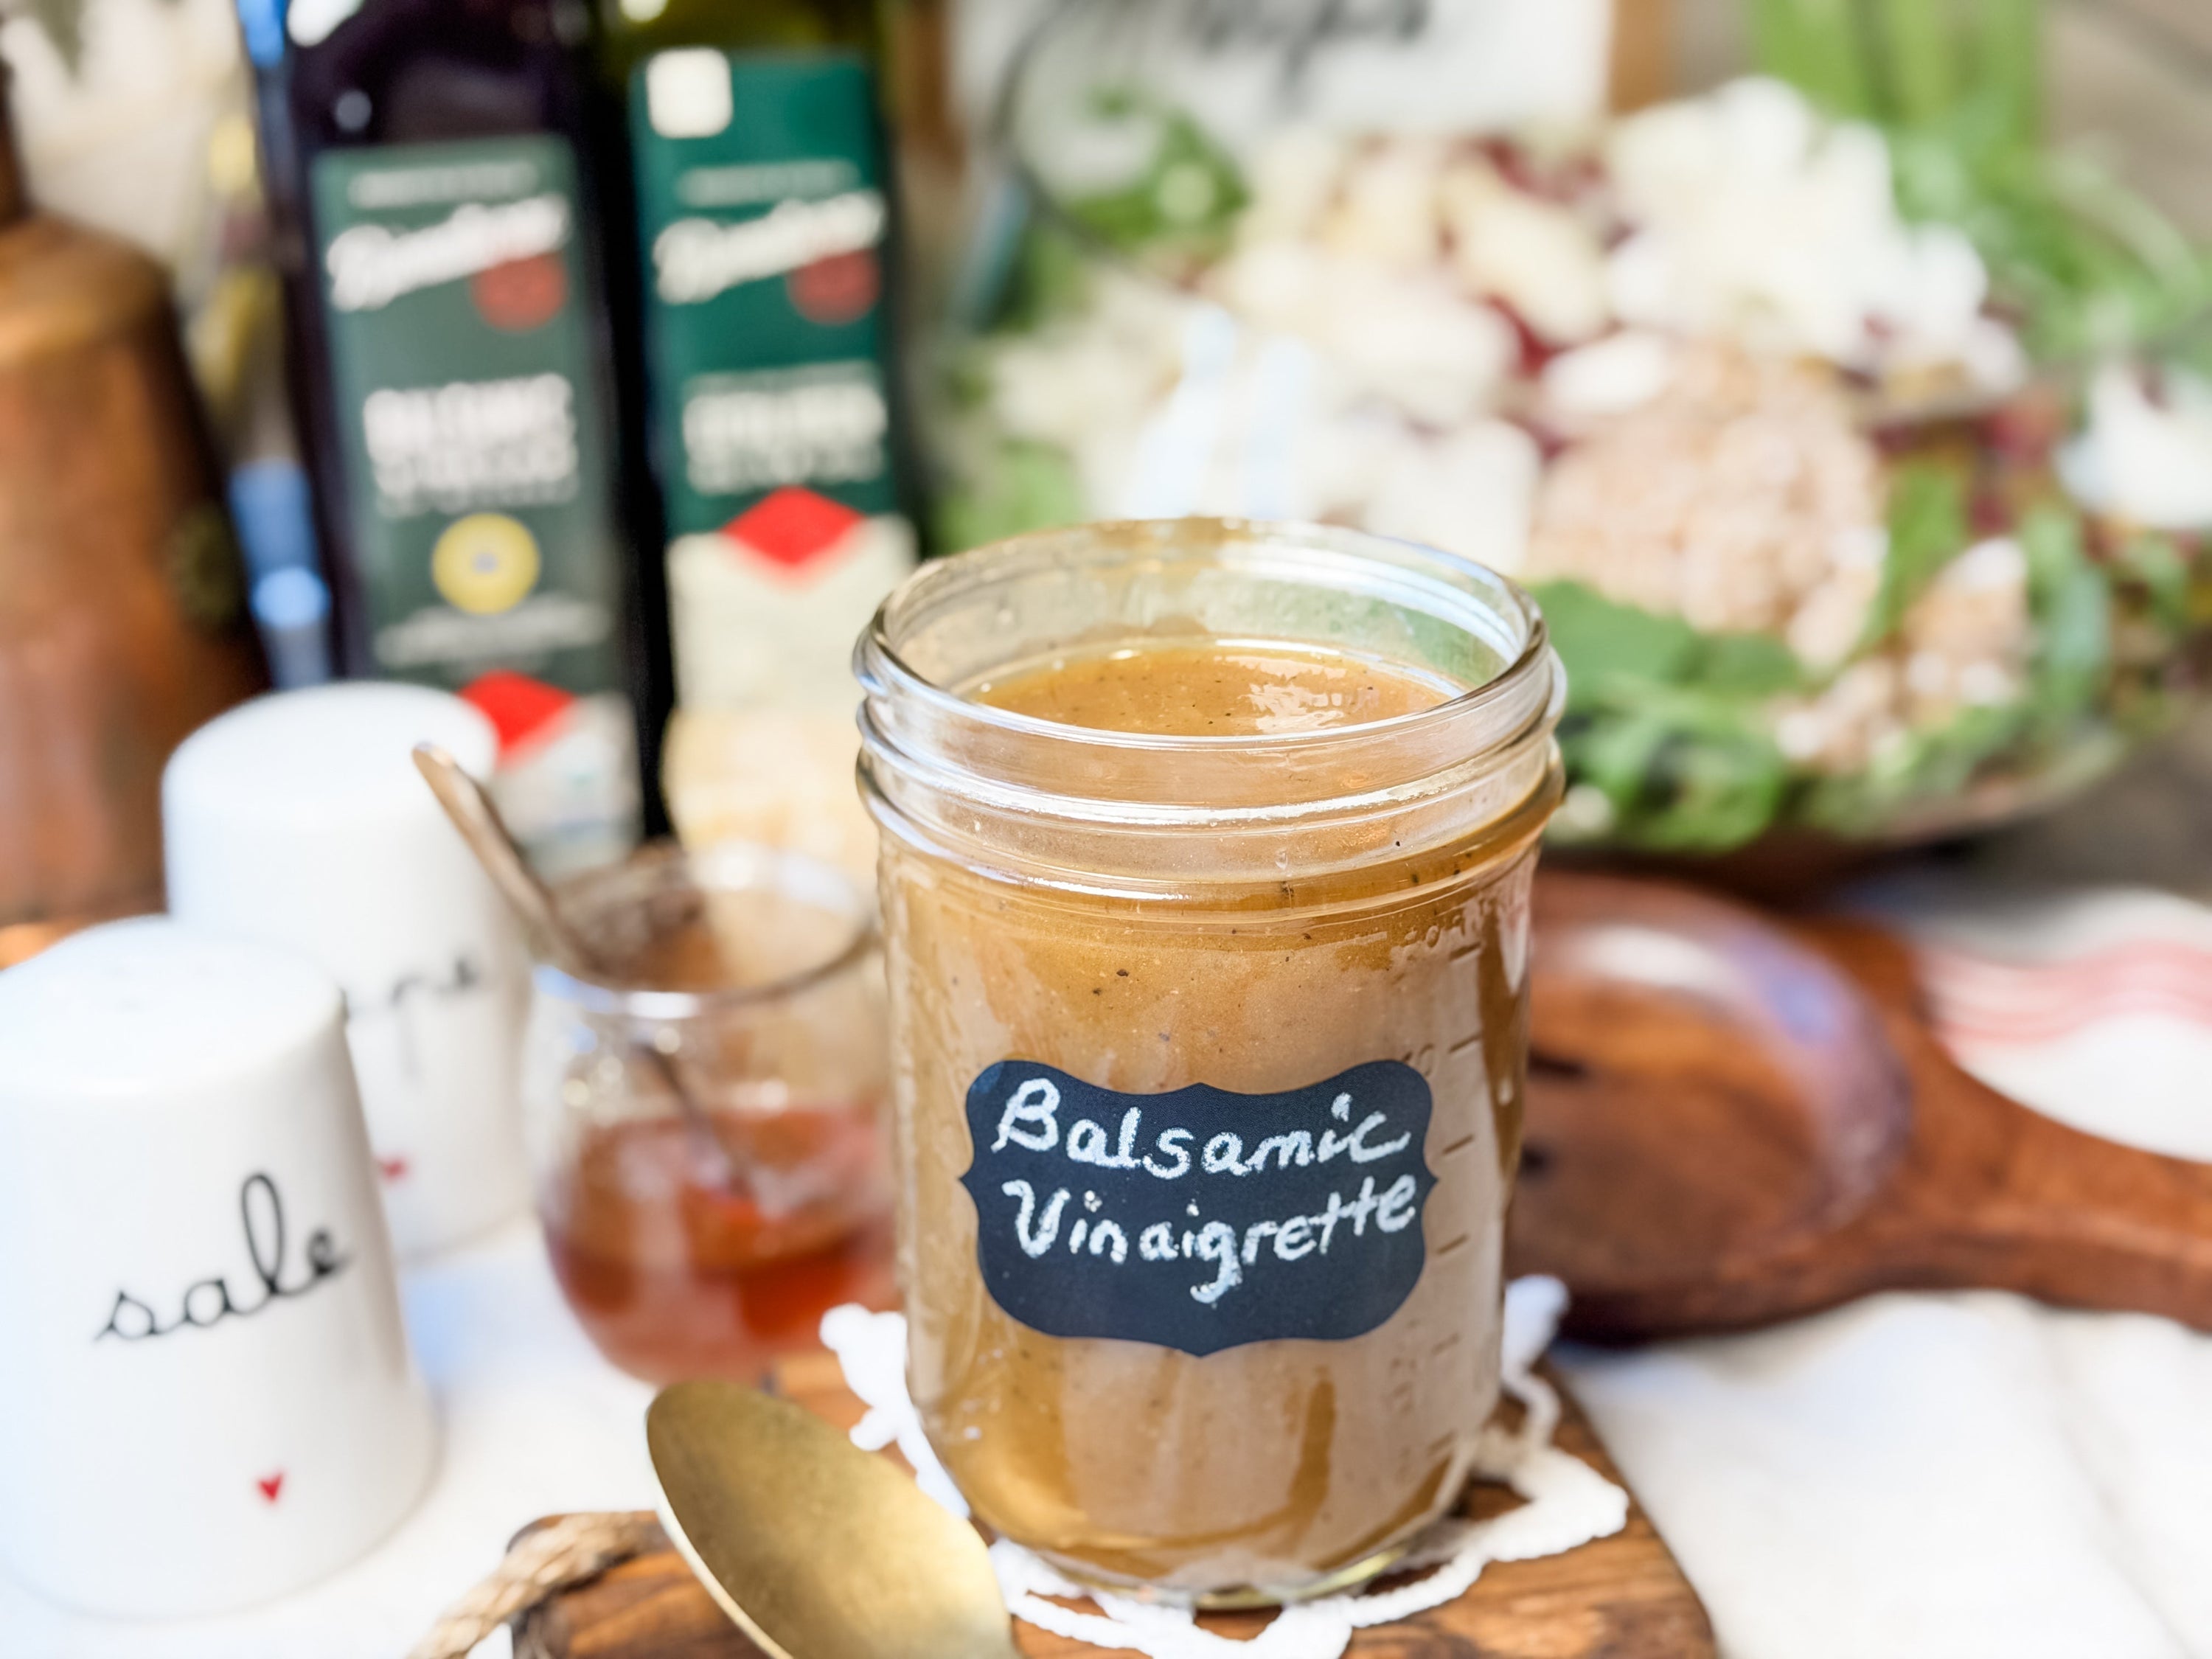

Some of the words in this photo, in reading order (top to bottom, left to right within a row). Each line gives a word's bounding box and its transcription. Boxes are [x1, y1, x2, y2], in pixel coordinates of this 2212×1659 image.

[992, 1077, 1411, 1179] Balsamic
[95, 1173, 351, 1343] sale
[1002, 1175, 1416, 1304] Vinaigrette
